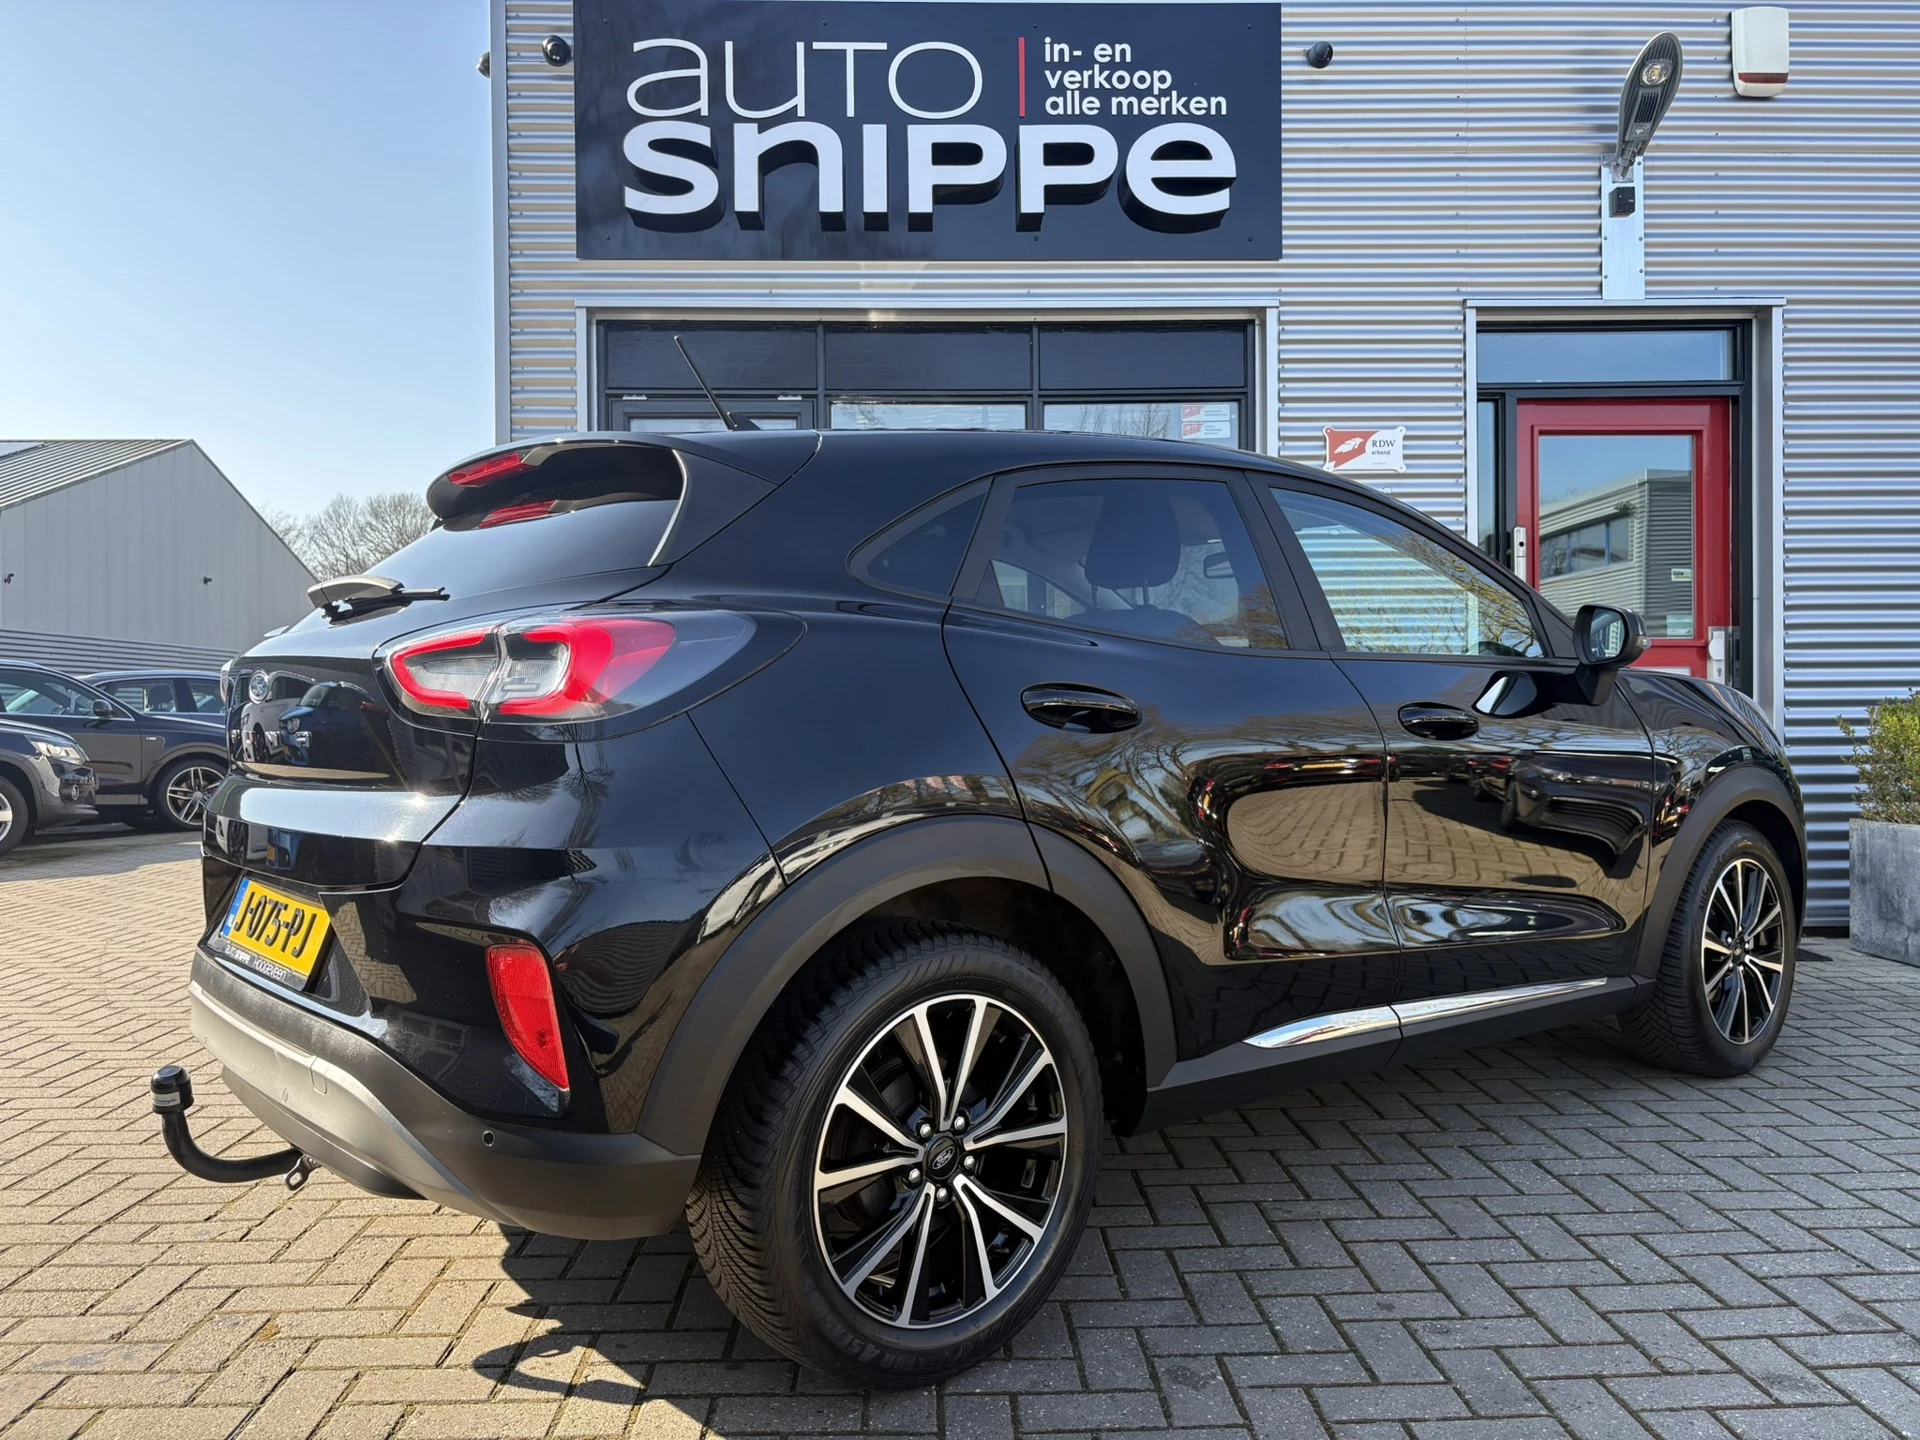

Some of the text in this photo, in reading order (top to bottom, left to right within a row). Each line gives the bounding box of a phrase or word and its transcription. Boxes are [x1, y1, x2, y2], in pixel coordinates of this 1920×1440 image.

[1044, 36, 1131, 62] in- en
[1044, 64, 1172, 95] verkoop
[1045, 90, 1227, 115] alle merken
[1371, 439, 1396, 448] RDW
[234, 891, 317, 959] J-075-PJ
